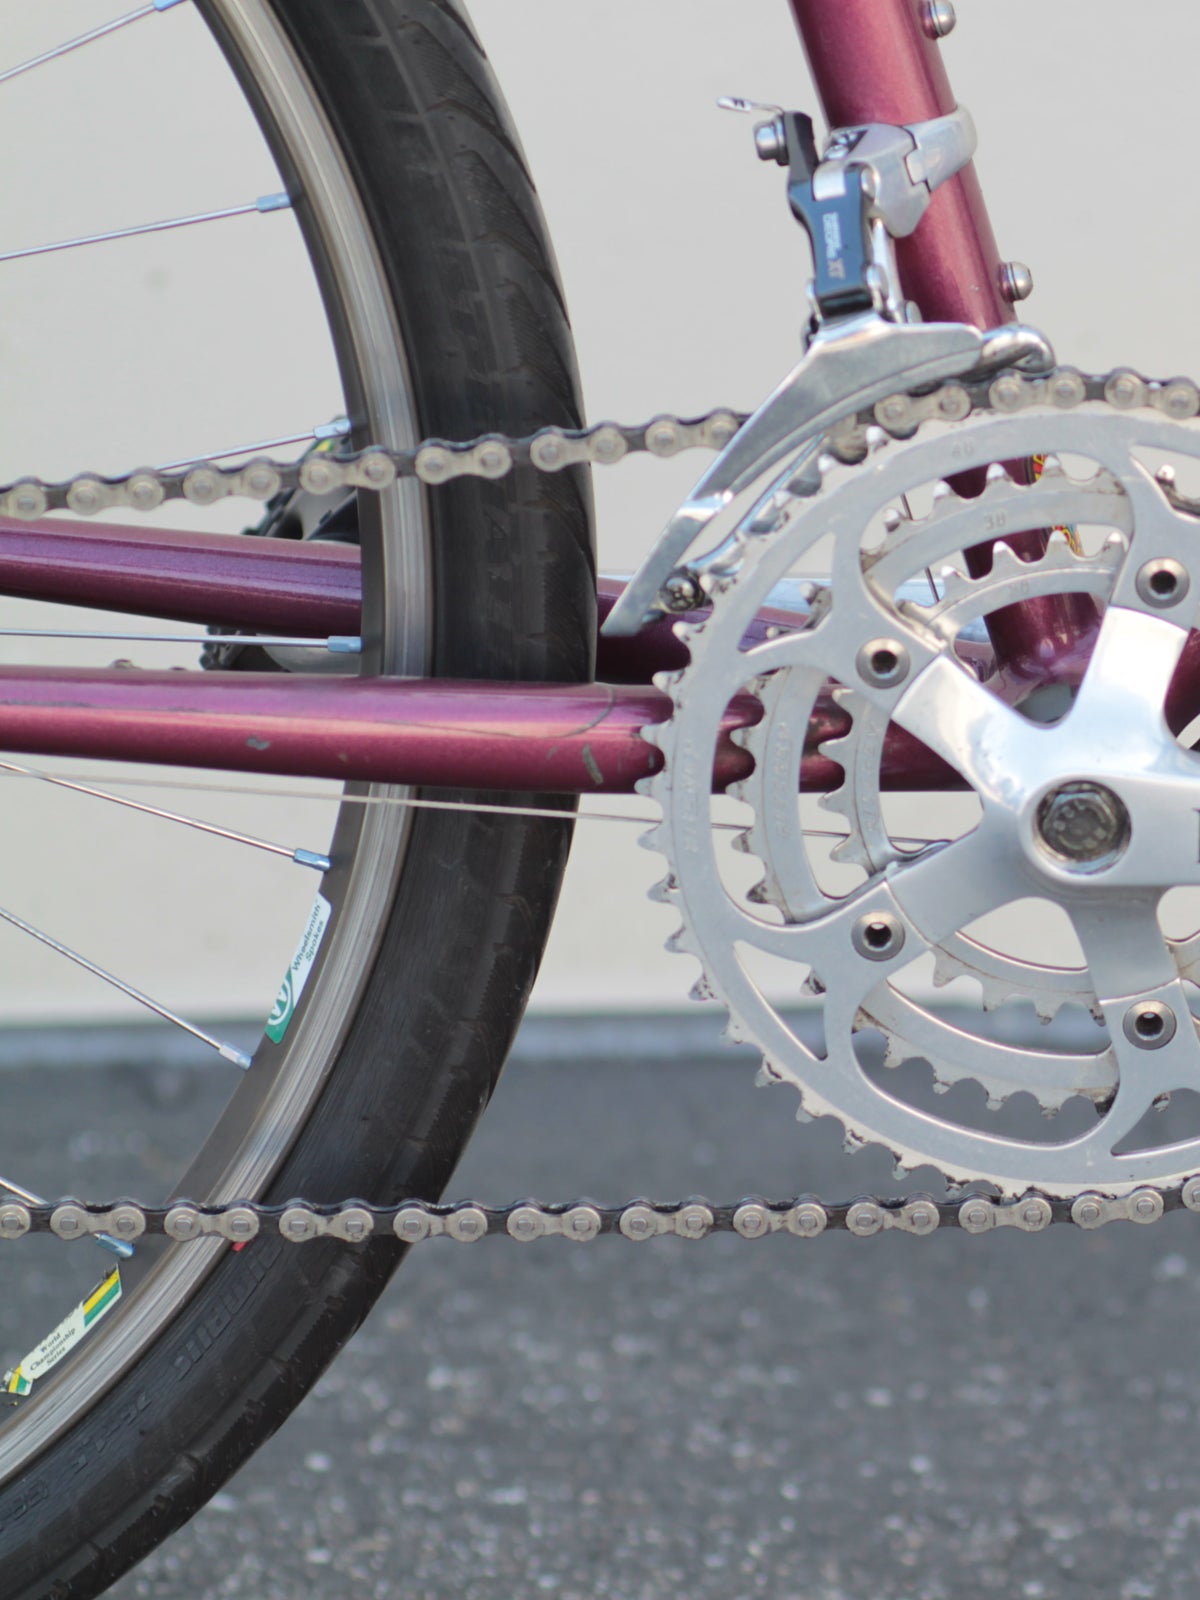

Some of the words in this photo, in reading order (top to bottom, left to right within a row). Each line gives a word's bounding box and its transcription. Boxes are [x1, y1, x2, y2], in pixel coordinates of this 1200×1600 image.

[292, 904, 321, 971] Wheelsmith
[305, 920, 324, 962] Spokes
[30, 1328, 76, 1371] Championship
[40, 1332, 61, 1352] World
[47, 1346, 66, 1366] Series
